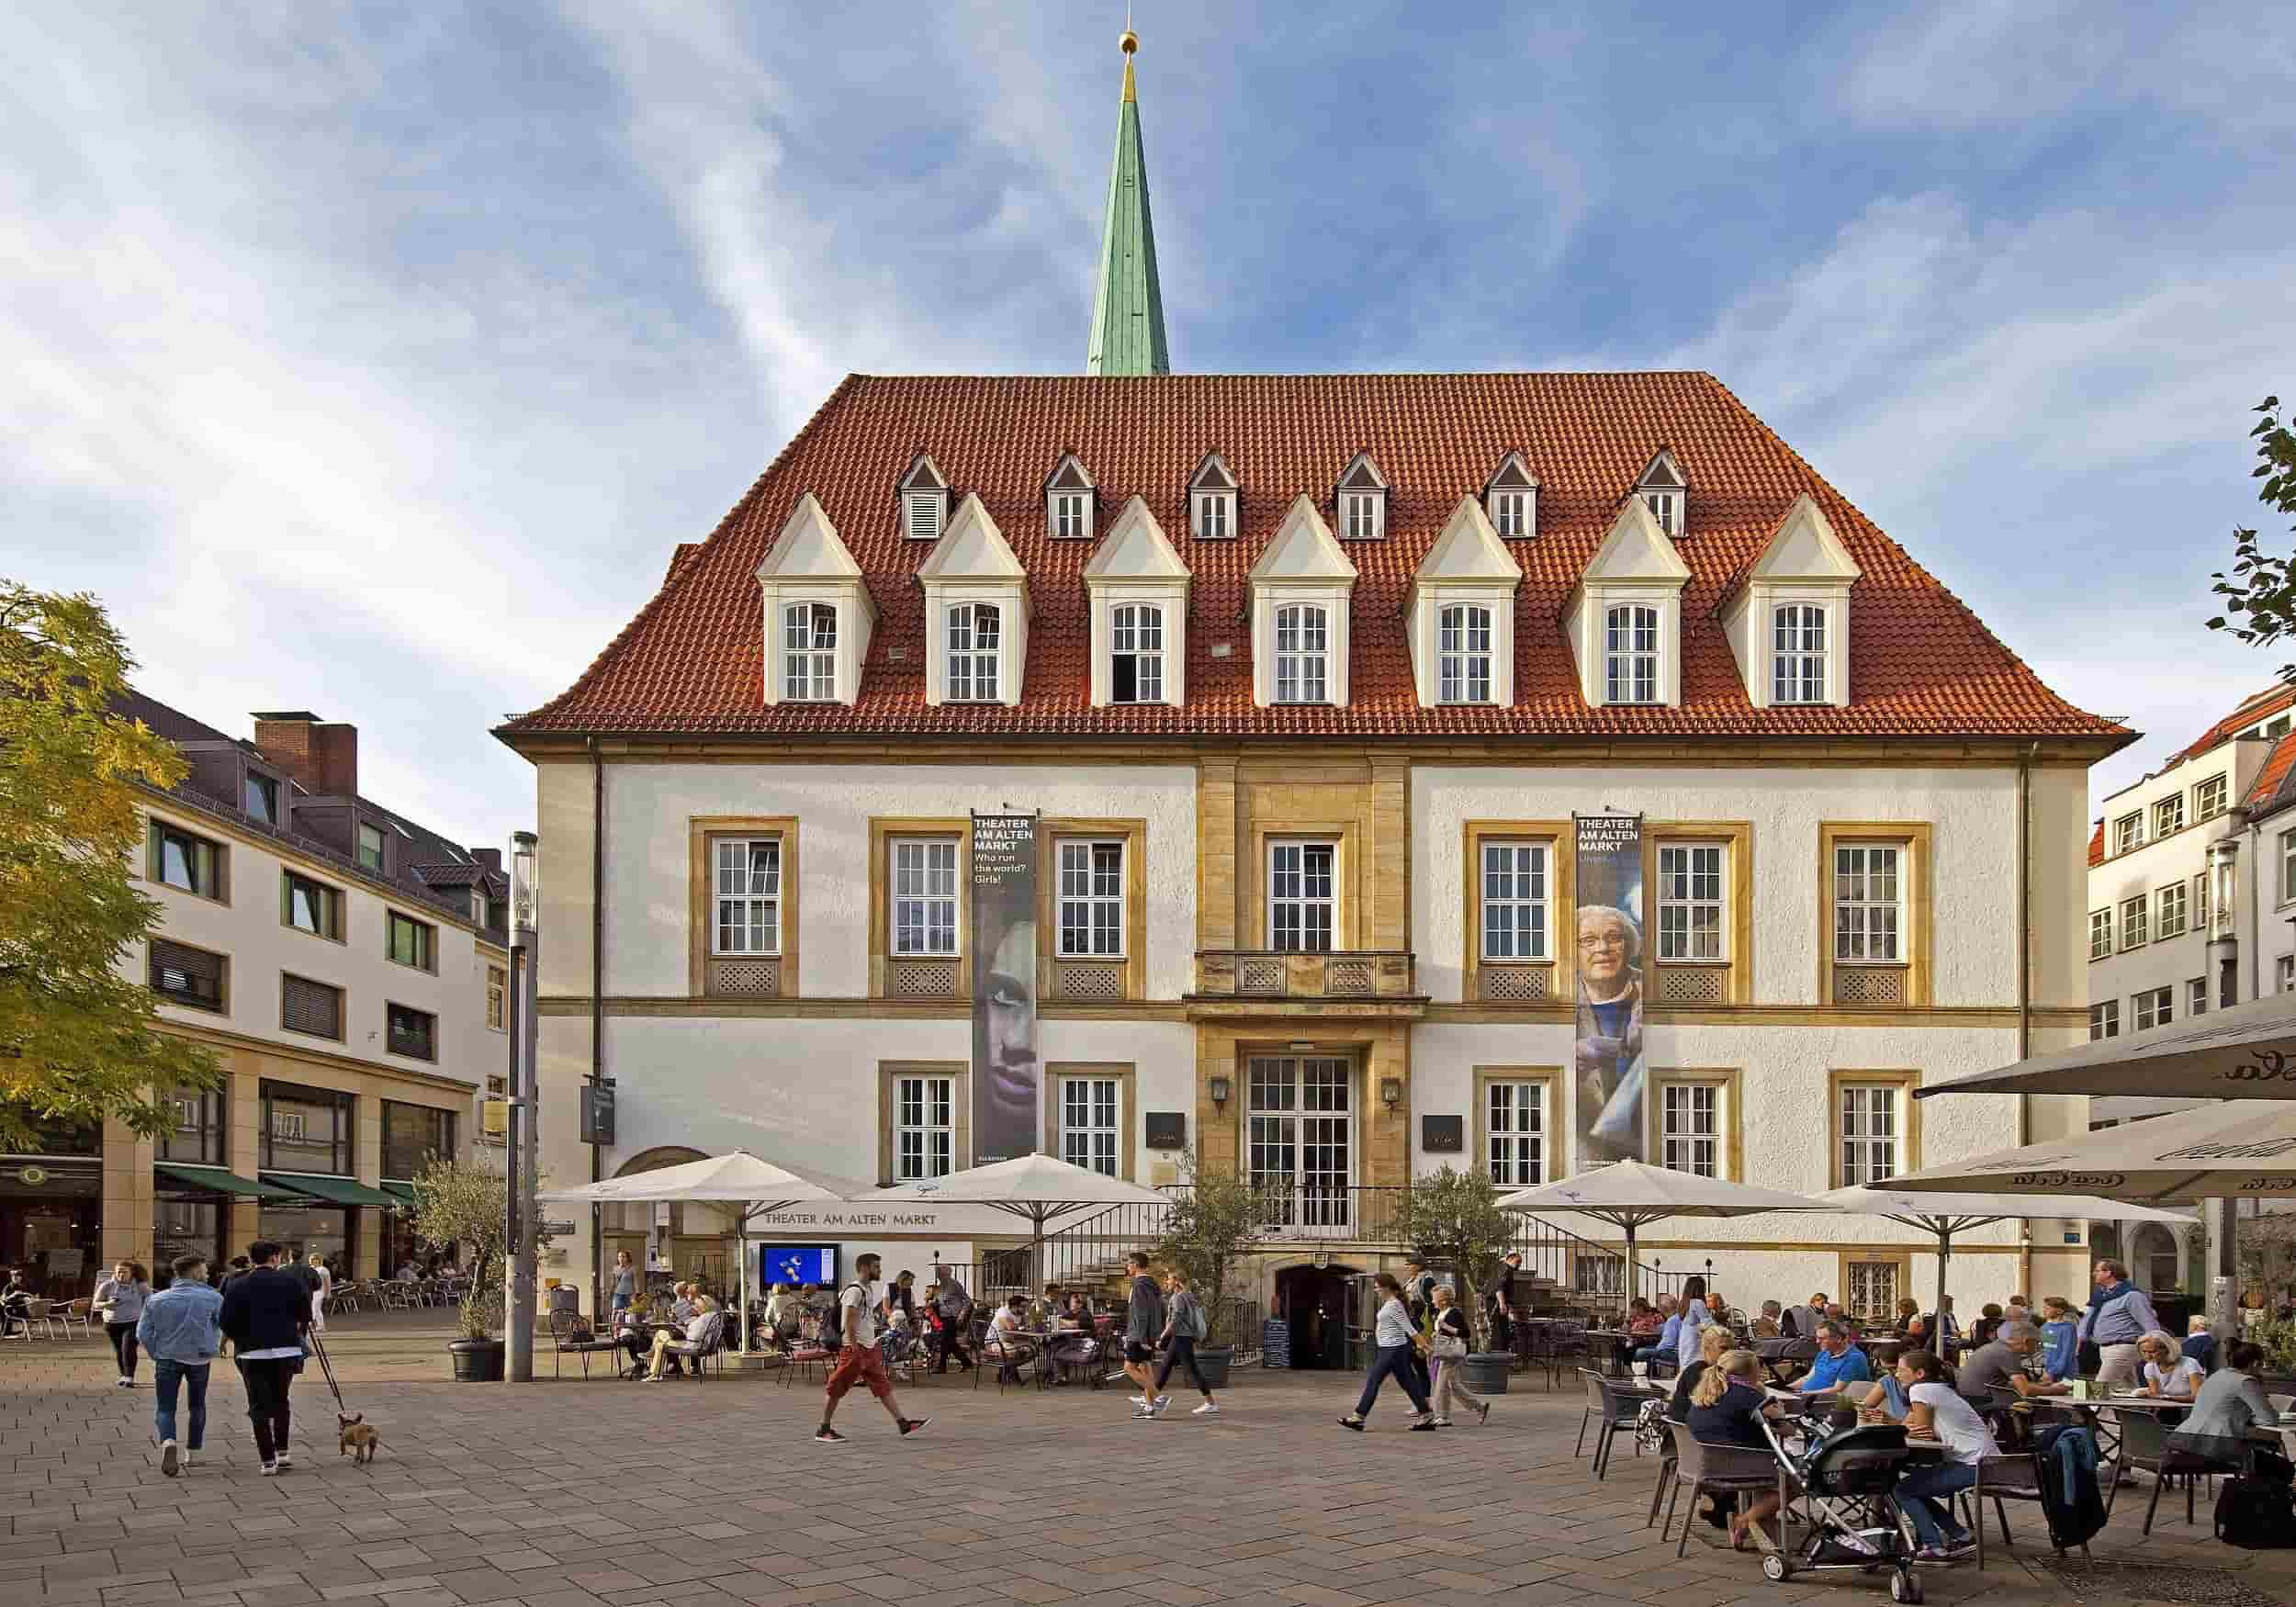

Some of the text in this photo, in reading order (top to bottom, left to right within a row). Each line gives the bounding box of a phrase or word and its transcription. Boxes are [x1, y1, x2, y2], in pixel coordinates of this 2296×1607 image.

[974, 818, 1029, 828] THEATER
[1579, 819, 1633, 829] THEATER
[975, 829, 1033, 839] AM ALTEN
[1579, 830, 1638, 840] AM ALTEN
[975, 840, 1017, 850] MARKT
[1579, 842, 1622, 852] MARKT
[975, 853, 996, 861] Who
[993, 863, 1027, 872] world?
[765, 1214, 936, 1225] THEATER AM ALTEN MARKT
